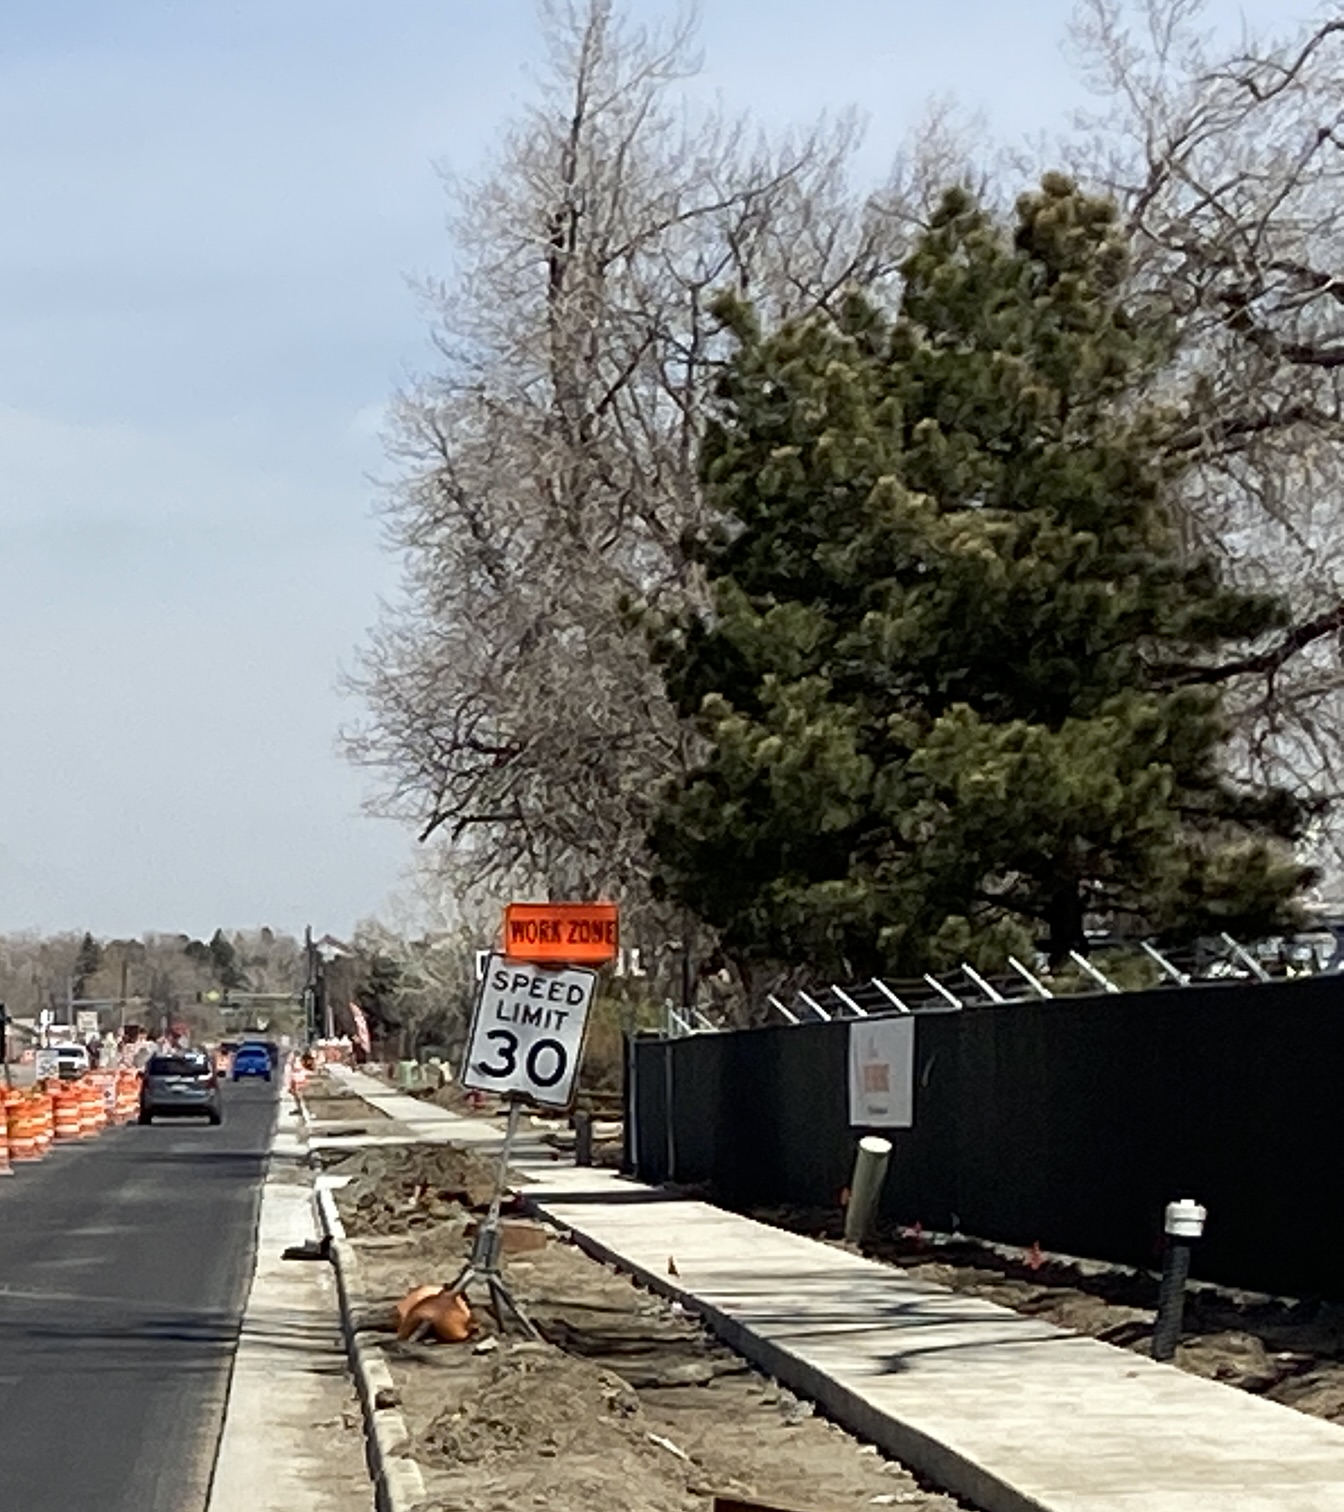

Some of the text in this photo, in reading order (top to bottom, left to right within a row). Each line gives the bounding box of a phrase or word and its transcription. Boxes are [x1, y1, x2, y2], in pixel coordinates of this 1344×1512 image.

[510, 920, 616, 943] WORK ZONE
[492, 970, 585, 1005] SPEED
[496, 1000, 569, 1031] LIMIT
[478, 1029, 567, 1087] 30
